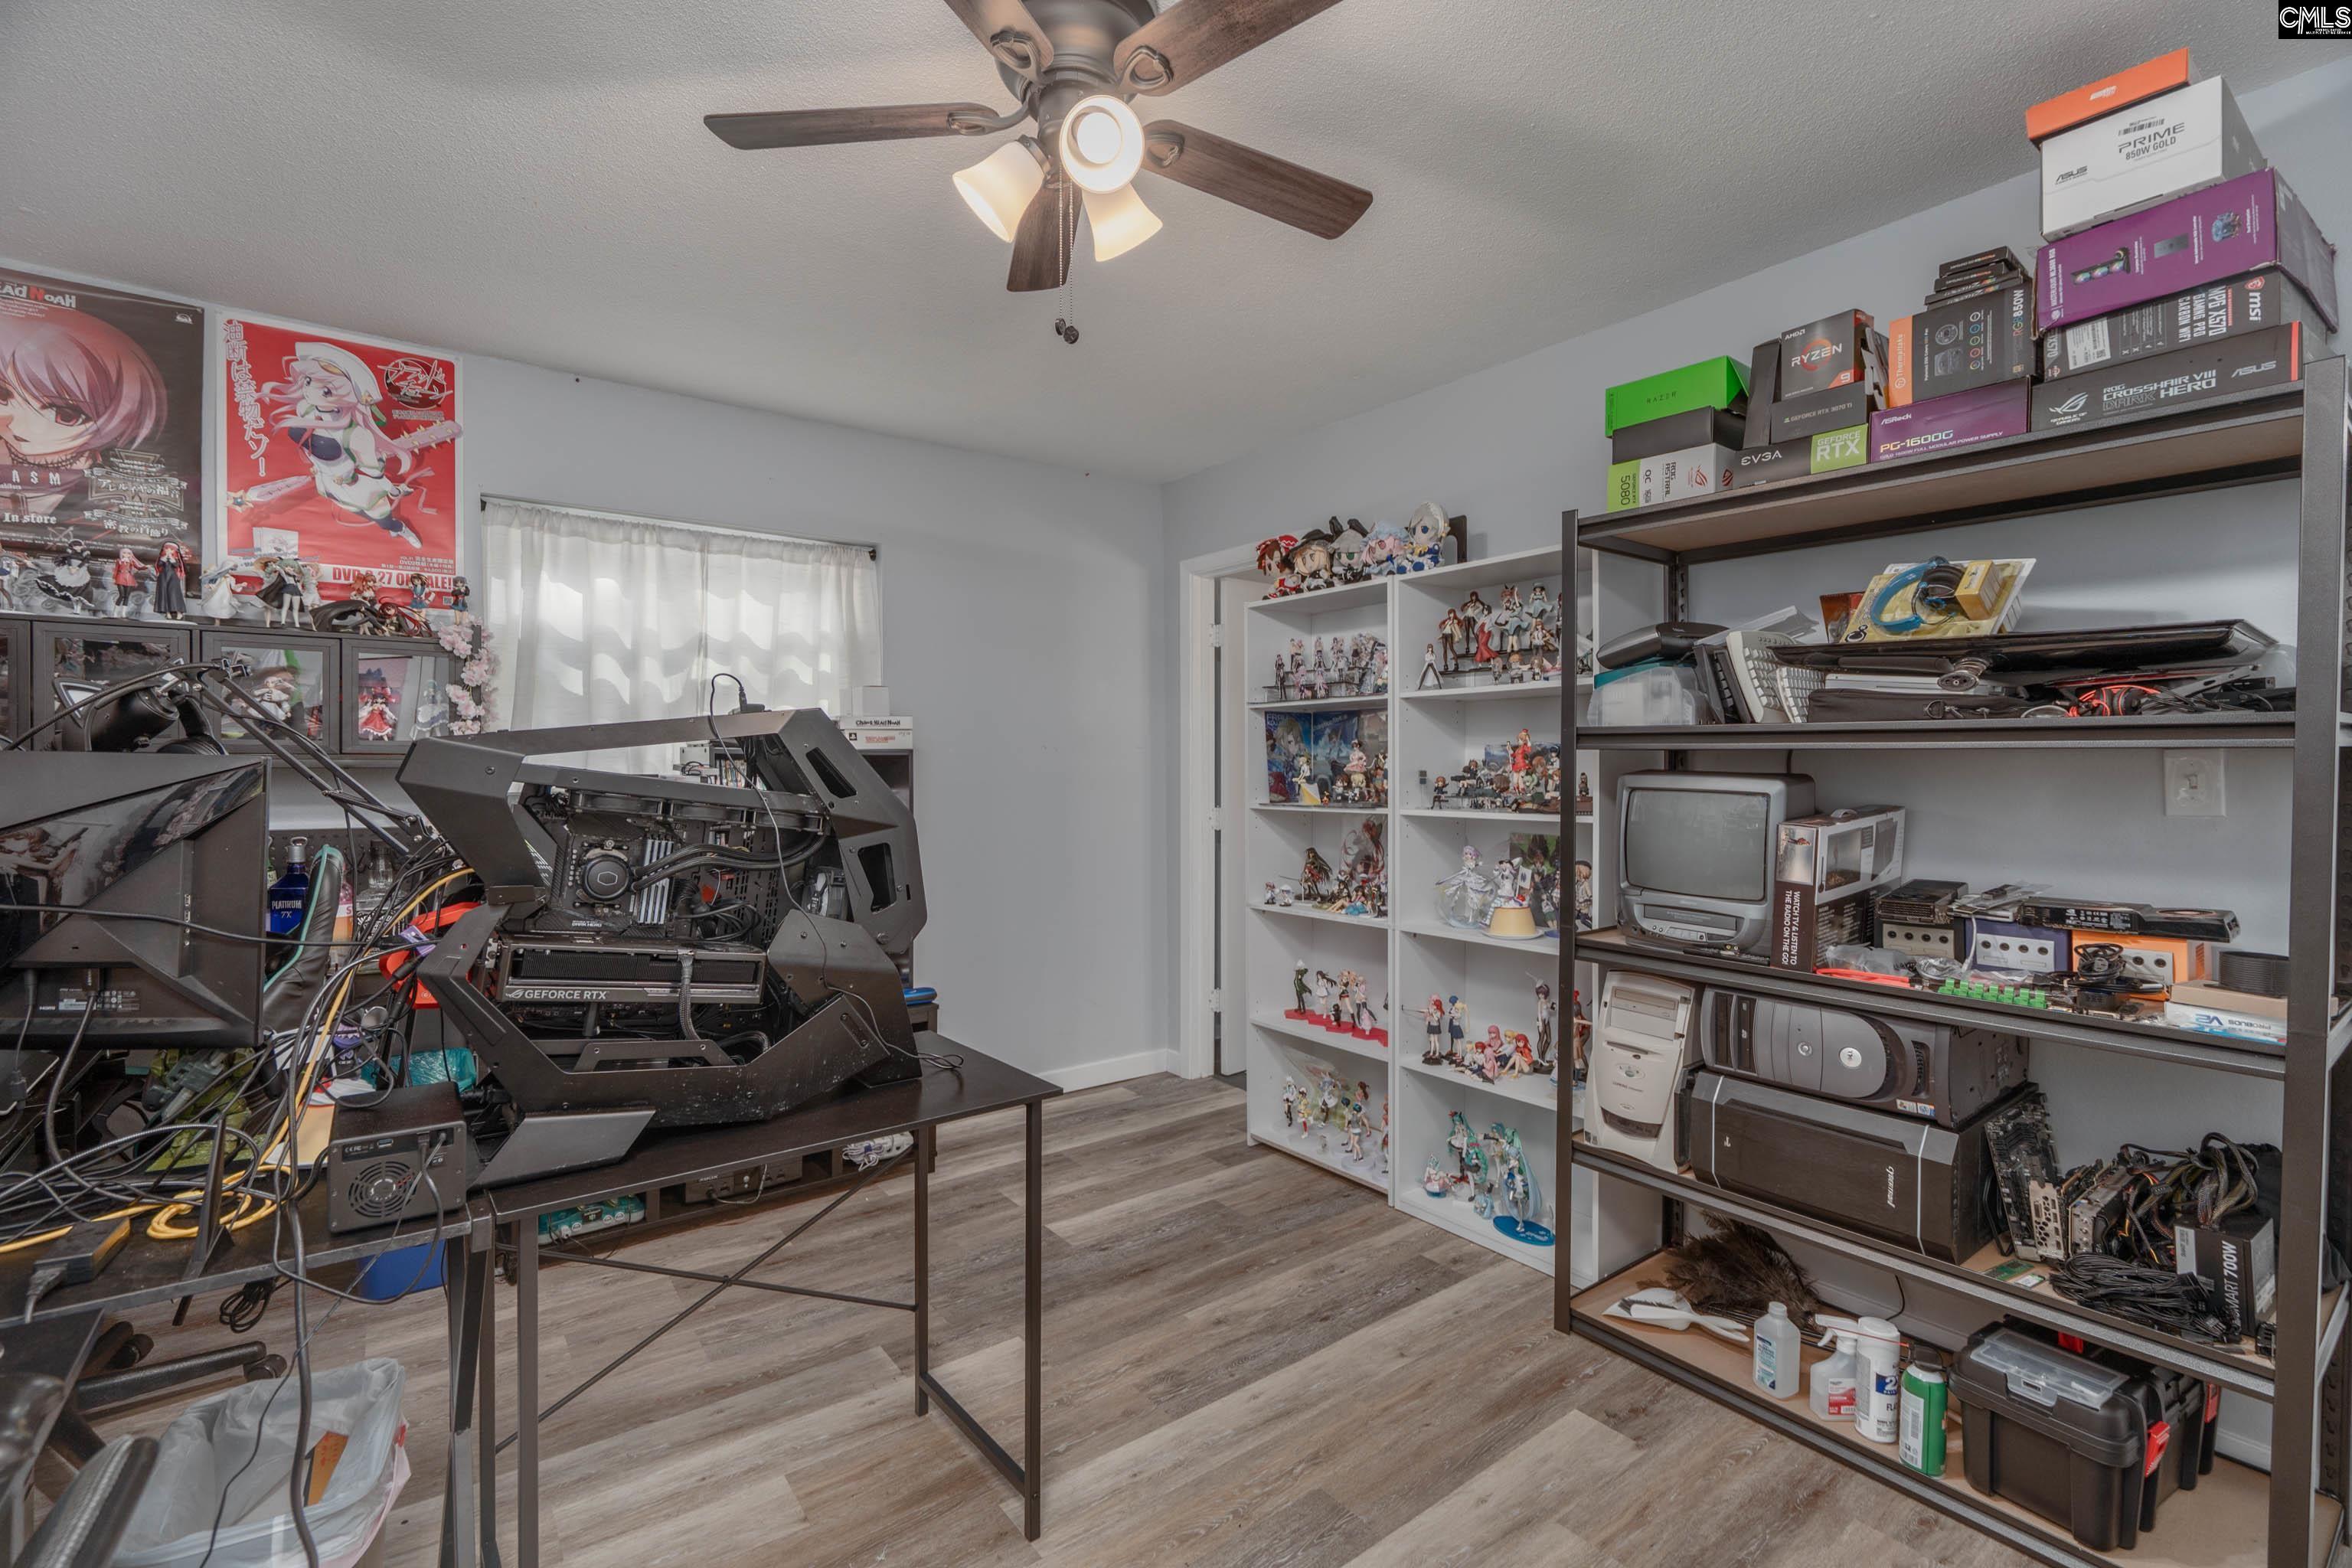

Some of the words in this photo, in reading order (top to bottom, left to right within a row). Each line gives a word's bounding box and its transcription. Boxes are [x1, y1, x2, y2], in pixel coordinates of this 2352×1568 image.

[2118, 122, 2184, 153] PRIME
[2125, 145, 2151, 161] 850W
[2152, 136, 2176, 151] GOLD
[2055, 166, 2088, 182] ASUS
[2208, 286, 2226, 309] MPG
[2178, 296, 2190, 326] CARBON
[2193, 293, 2205, 320] GAMING
[2249, 292, 2262, 322] msi
[2194, 322, 2206, 338] PRO
[2209, 309, 2227, 337] X570
[1785, 329, 1802, 340] AMD
[2179, 326, 2191, 344] WIFI
[1791, 343, 1843, 367] RYZEN
[1840, 373, 1851, 383] 9
[2231, 361, 2277, 378] ASUS
[2103, 375, 2189, 402] CROSSHAIR
[2193, 369, 2216, 381] VIII
[2103, 383, 2125, 393] ROG
[2103, 391, 2157, 411] DARK
[2160, 377, 2216, 399] HERO
[1646, 391, 1677, 403] RAZER
[1790, 410, 1816, 421] GEFORCE
[1818, 408, 1828, 416] RTX
[1831, 404, 1846, 413] 3070
[1880, 413, 1912, 425] ASRock
[1817, 430, 1860, 446] GEFORCE
[1880, 430, 1954, 452] PG-1600G
[1929, 441, 1957, 450] MODULAR
[1957, 436, 1978, 445] POWER
[1979, 431, 2003, 440] SUPPLY
[1741, 449, 1782, 466] EVGA
[1816, 439, 1860, 462] RTX
[1645, 469, 1651, 483] OC
[1621, 475, 1631, 505] 5080
[3, 512, 19, 523] In
[24, 514, 57, 524] store
[272, 900, 302, 910] PLATINUM
[1792, 891, 1801, 918] WATCH
[1783, 928, 1790, 937] ON
[1790, 956, 1798, 965] TO
[524, 990, 580, 999] GEFORCE
[583, 991, 607, 1000] RTX
[2222, 1240, 2238, 1279] 700W
